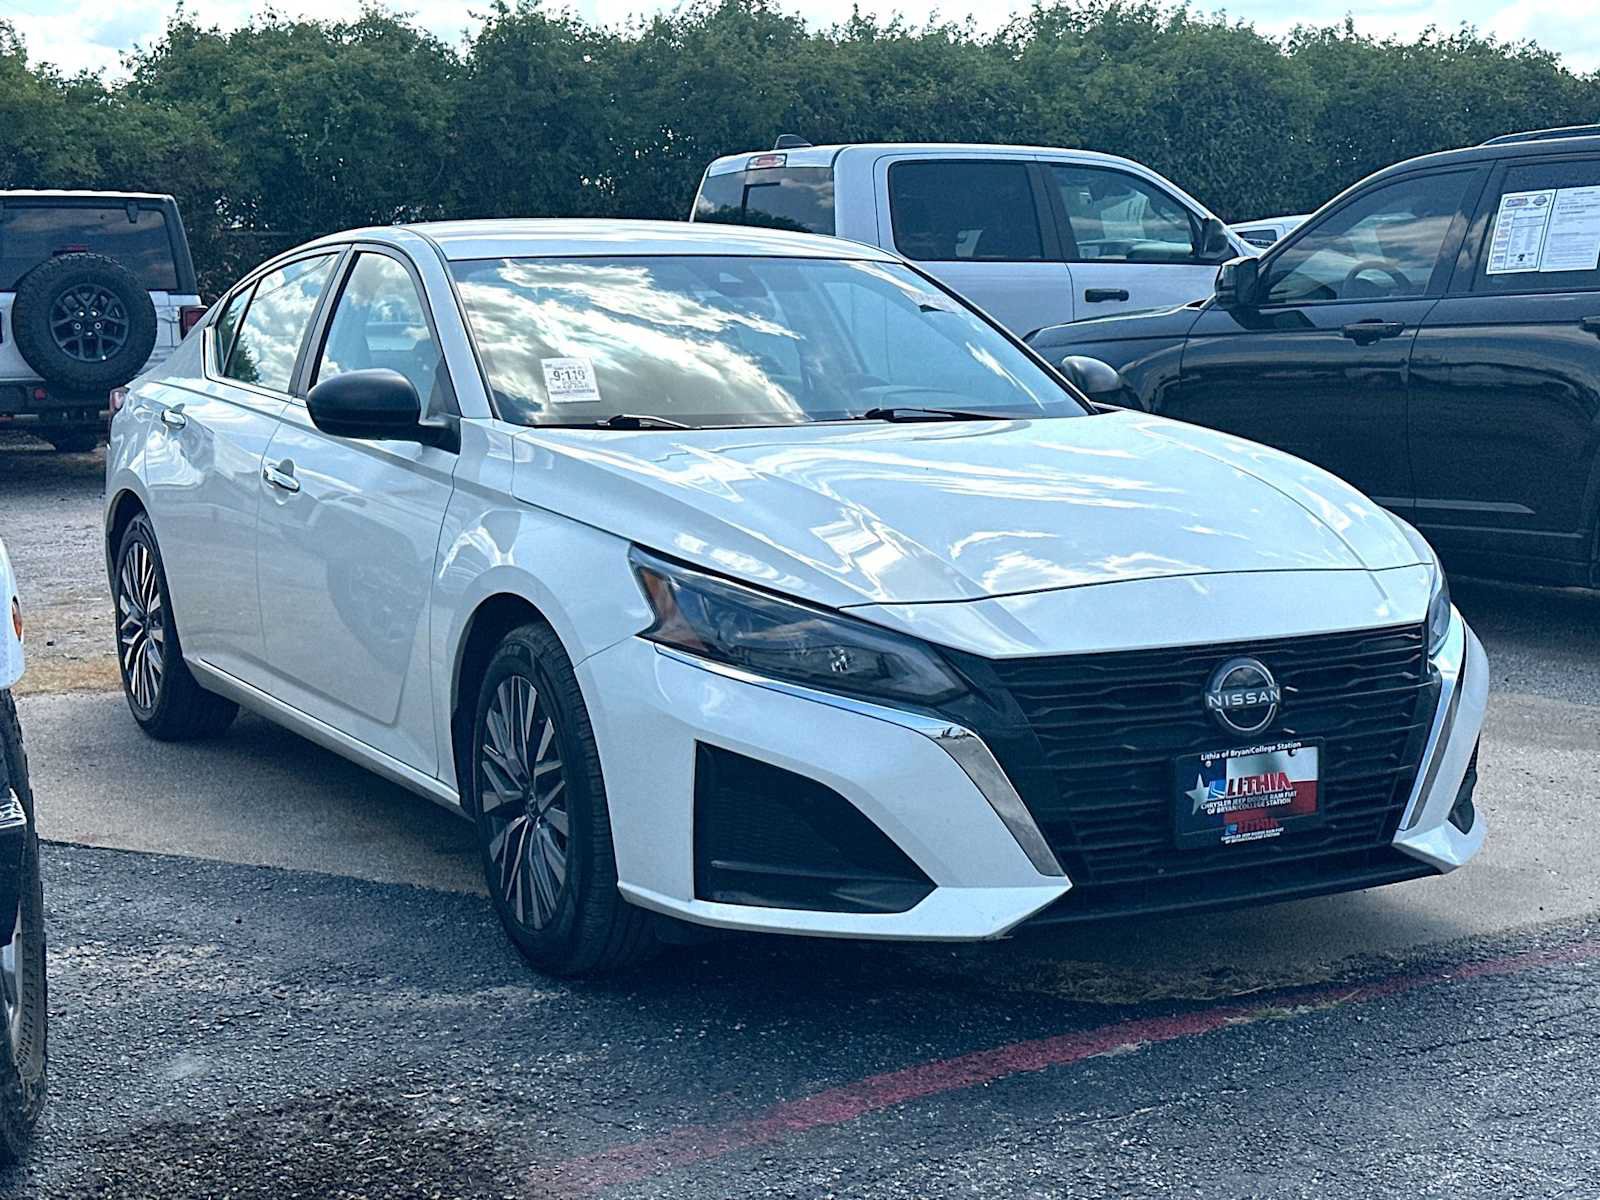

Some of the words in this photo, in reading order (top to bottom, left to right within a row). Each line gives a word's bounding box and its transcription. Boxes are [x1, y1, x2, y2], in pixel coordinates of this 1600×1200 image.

[1208, 689, 1280, 706] NISSAN
[1201, 752, 1220, 761] Lithia
[1221, 750, 1229, 758] of
[1277, 741, 1302, 751] Station
[1226, 772, 1294, 798] LITHIA
[1201, 799, 1231, 810] CHRYSLER
[1232, 797, 1247, 805] JEEP
[1269, 793, 1284, 801] RAM
[1284, 790, 1297, 799] FIAT
[1207, 807, 1215, 815] OF
[1266, 797, 1292, 807] STATION
